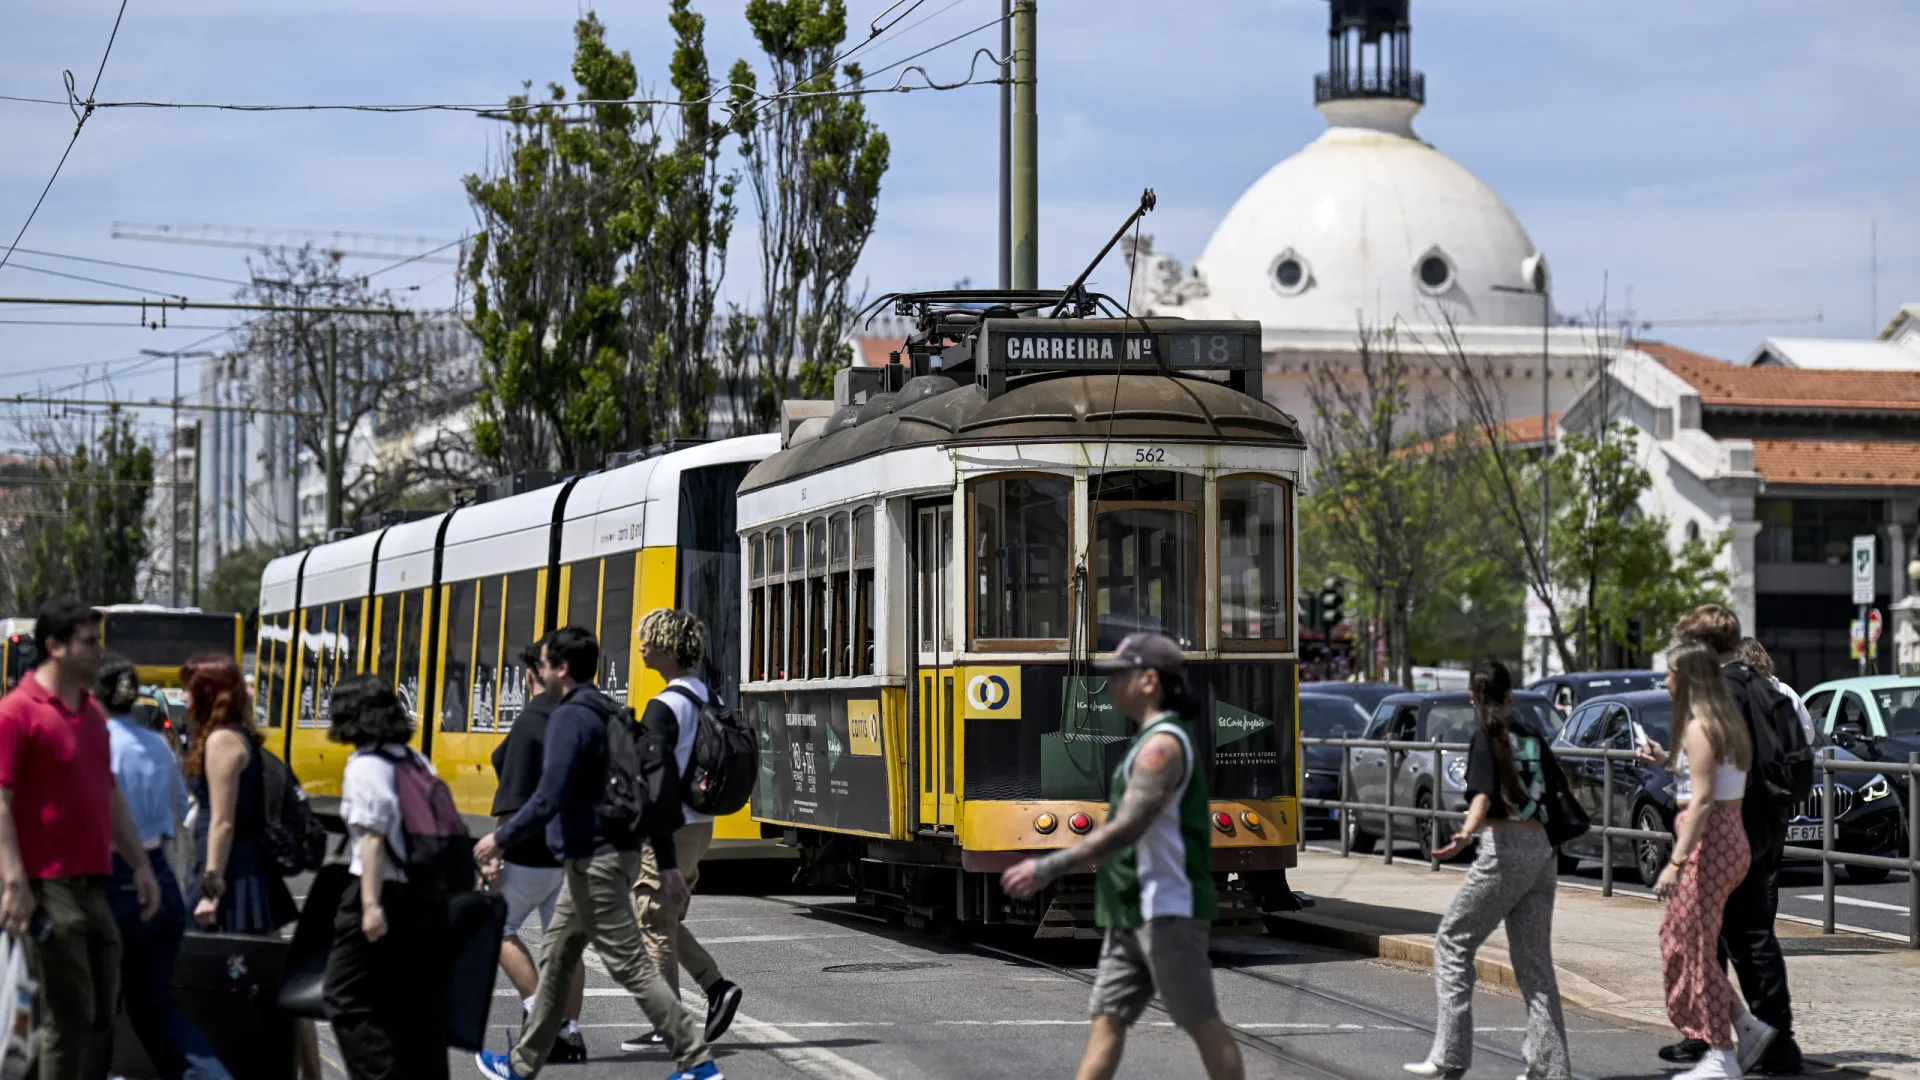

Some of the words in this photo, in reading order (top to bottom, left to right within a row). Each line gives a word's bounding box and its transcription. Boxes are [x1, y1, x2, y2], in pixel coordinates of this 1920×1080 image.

[1007, 337, 1114, 360] CARREIRA
[1126, 338, 1152, 361] Nº
[1190, 335, 1230, 363] 18
[1135, 448, 1165, 462] 562
[1226, 717, 1243, 727] Corte
